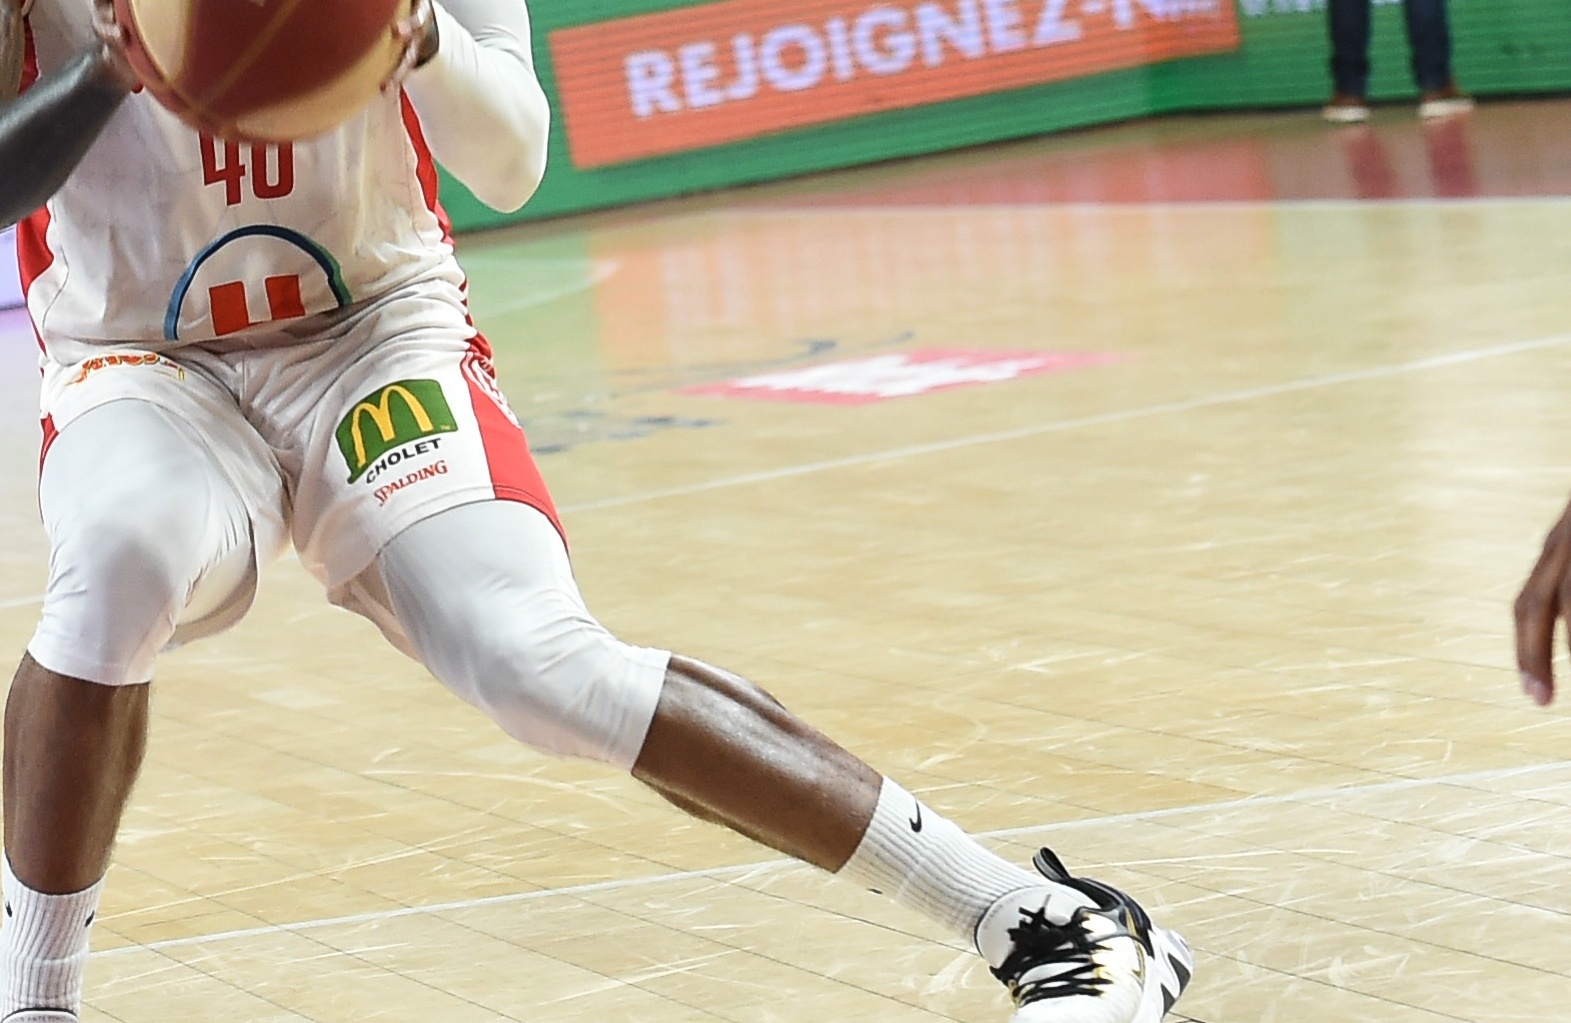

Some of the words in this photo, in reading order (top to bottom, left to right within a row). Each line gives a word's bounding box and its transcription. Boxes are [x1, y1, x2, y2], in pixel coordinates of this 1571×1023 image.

[198, 130, 295, 207] 40
[366, 438, 442, 484] CHOLET
[374, 460, 448, 507] SPALDING
